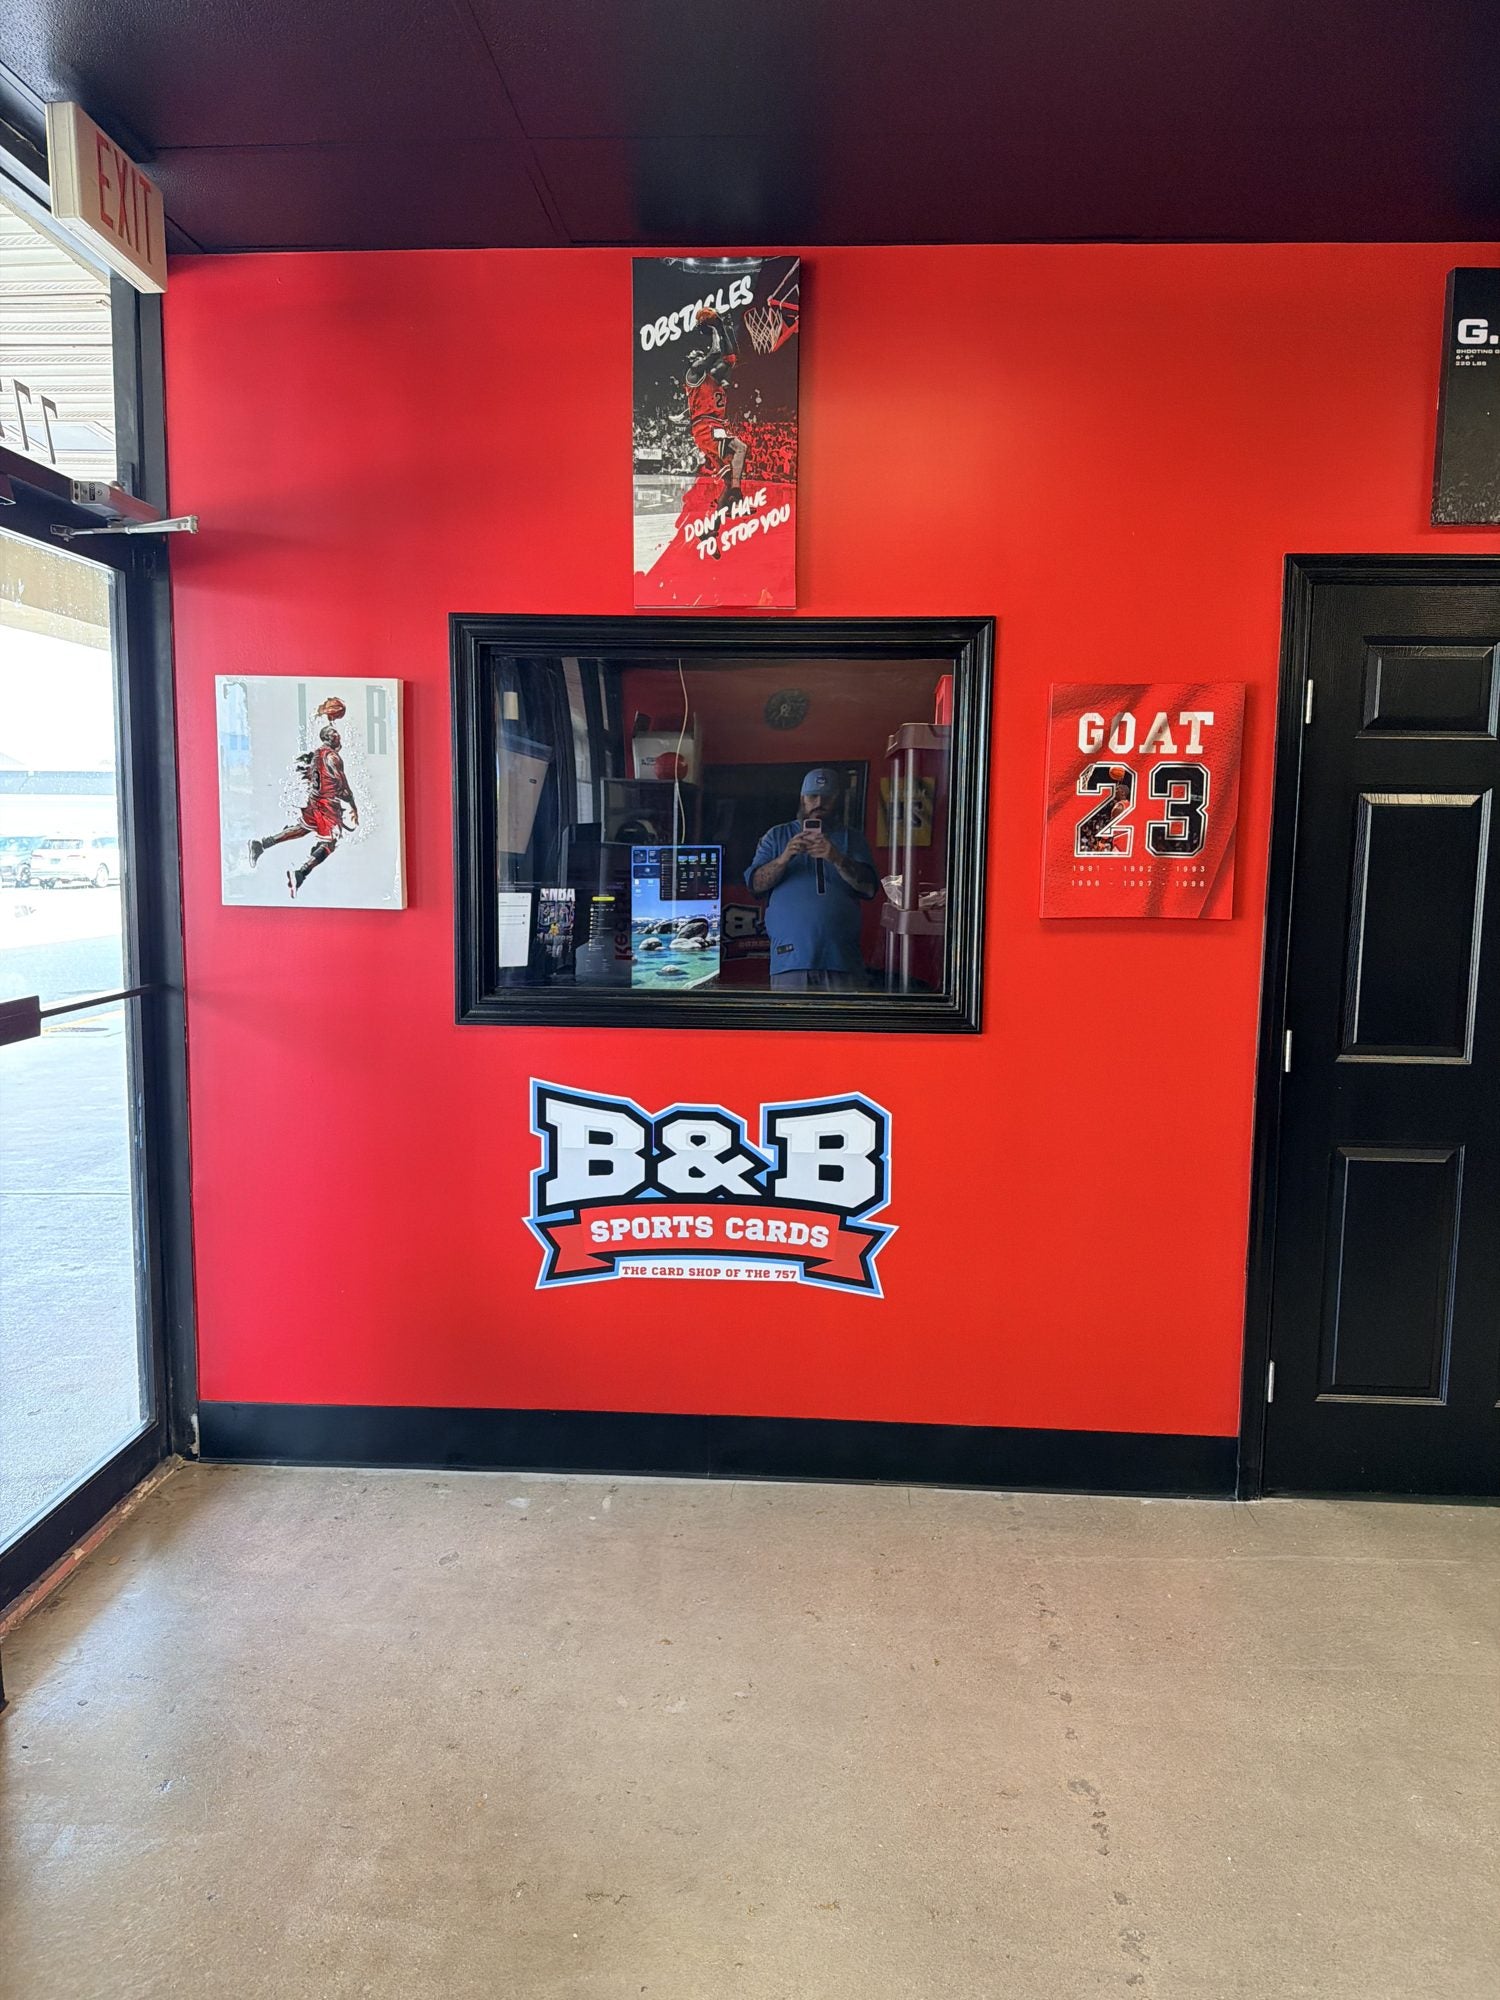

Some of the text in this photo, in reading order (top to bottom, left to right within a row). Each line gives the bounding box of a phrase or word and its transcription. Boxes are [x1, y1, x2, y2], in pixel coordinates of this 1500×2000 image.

[96, 130, 152, 265] EXIT
[1457, 318, 1499, 344] G.
[684, 487, 767, 543] DON'T HAVE
[697, 504, 790, 560] TO STOP YOU
[1078, 712, 1214, 754] GOAT
[1074, 761, 1211, 859] 23
[550, 888, 576, 902] NBA
[545, 1097, 876, 1209] B&B
[725, 1268, 741, 1278] OF
[774, 1269, 797, 1280] 757
